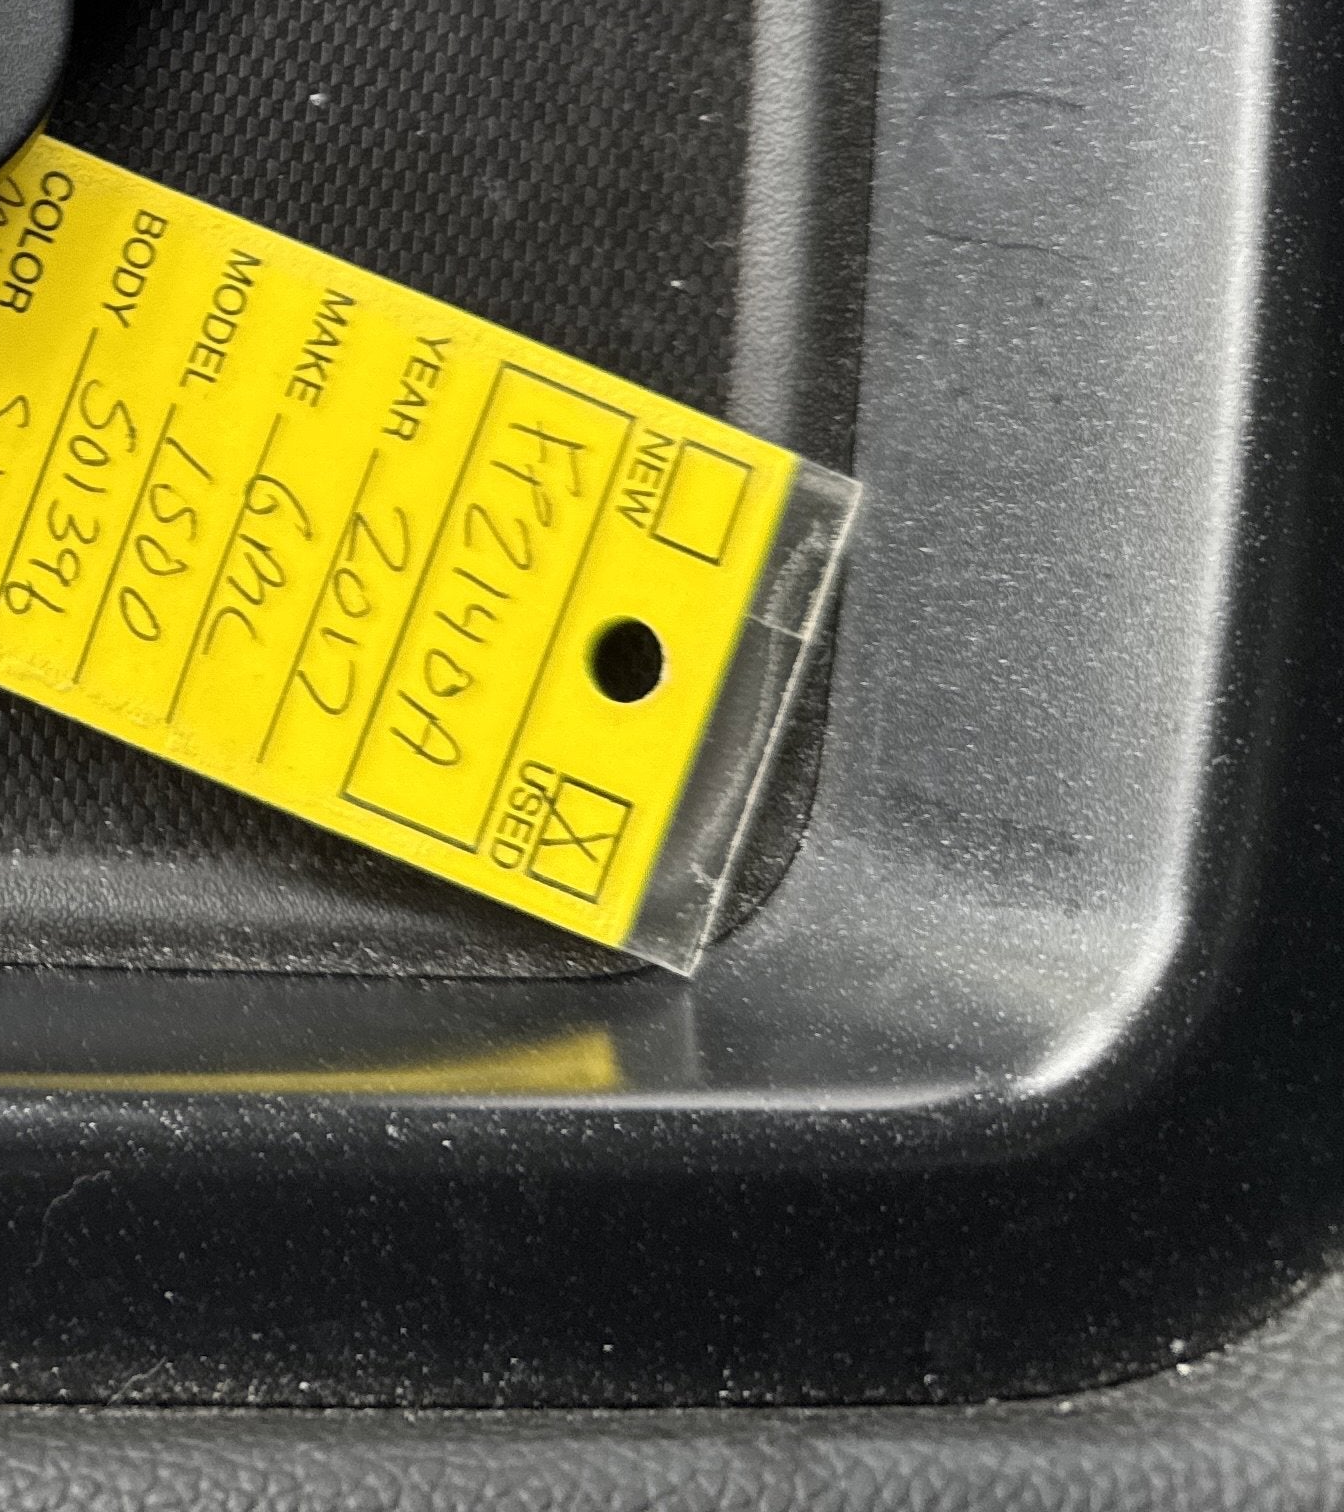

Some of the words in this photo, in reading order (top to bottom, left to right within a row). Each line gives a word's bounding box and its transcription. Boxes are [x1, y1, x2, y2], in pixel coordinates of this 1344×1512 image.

[100, 208, 169, 329] BODY
[179, 248, 263, 388] MODEL
[284, 287, 357, 408] MAKE
[383, 334, 452, 442] YEAR
[617, 427, 679, 529] NEW
[118, 437, 213, 641] 1500
[203, 473, 313, 655] GMC
[297, 506, 411, 716] 2017
[490, 759, 556, 870] USED
